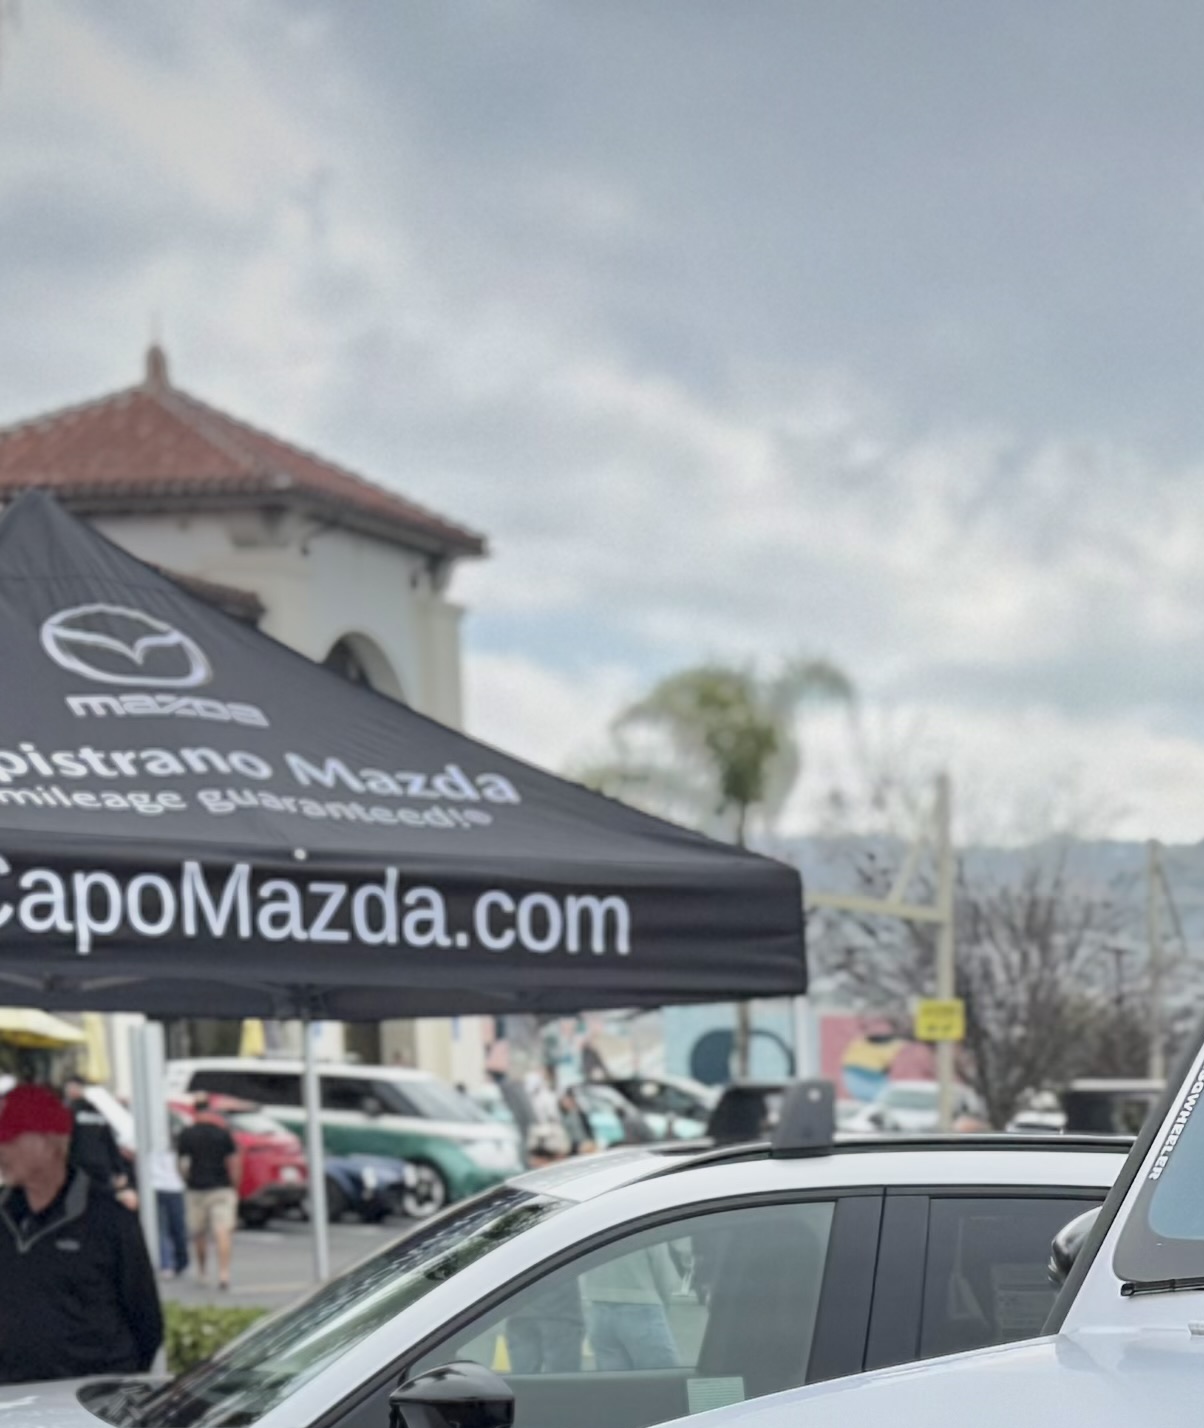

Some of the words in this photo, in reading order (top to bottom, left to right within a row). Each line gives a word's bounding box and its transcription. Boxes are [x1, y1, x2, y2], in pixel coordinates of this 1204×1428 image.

[0, 785, 188, 816] mileage
[284, 752, 522, 804] Mazda
[0, 855, 632, 956] apoMazda.com
